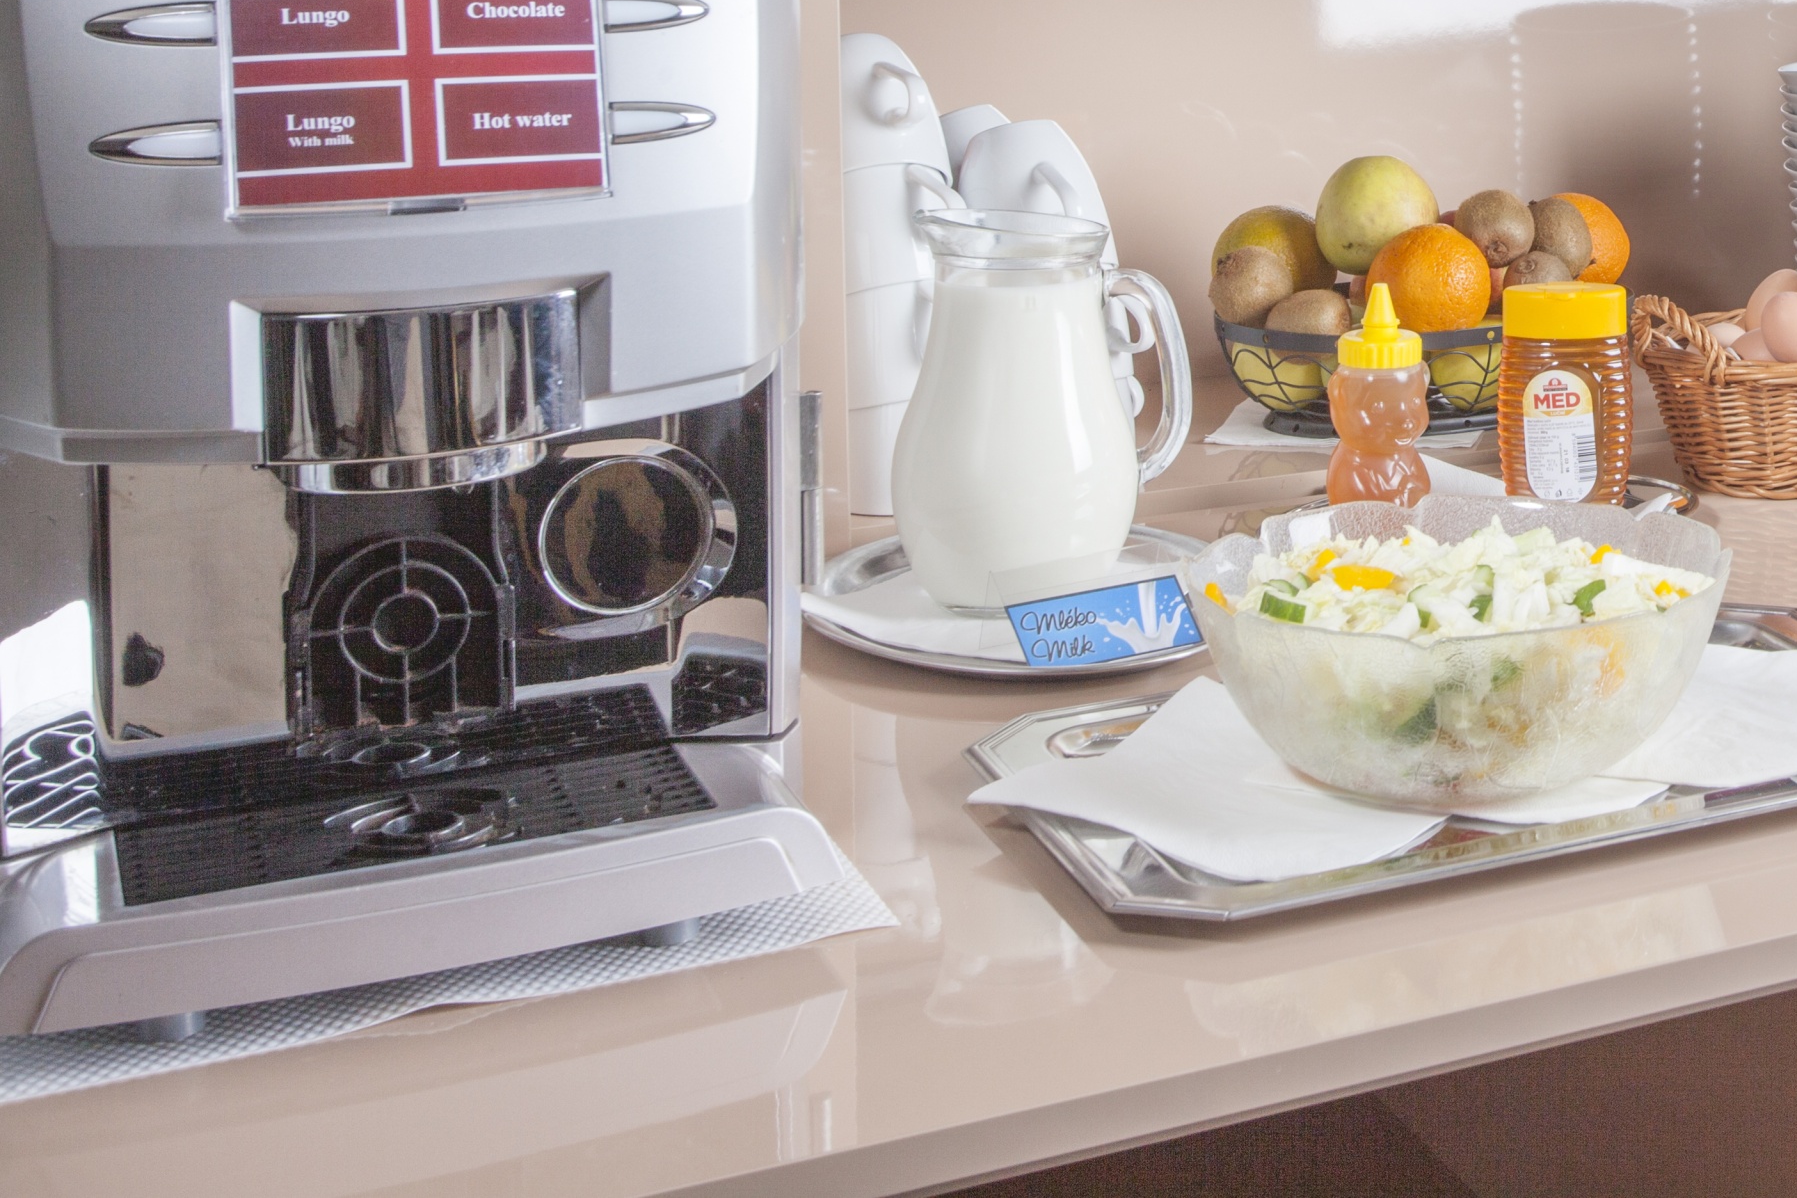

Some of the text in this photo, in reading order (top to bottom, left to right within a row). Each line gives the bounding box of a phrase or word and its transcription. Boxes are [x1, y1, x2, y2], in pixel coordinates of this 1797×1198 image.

[280, 7, 351, 29] Lungo
[466, 0, 566, 21] Chocolate
[285, 112, 356, 134] Lungo
[472, 111, 573, 130] Hot water
[288, 133, 355, 149] With milk
[1533, 392, 1581, 409] MED
[1019, 606, 1097, 635] Mléko
[1031, 634, 1096, 663] Milk
